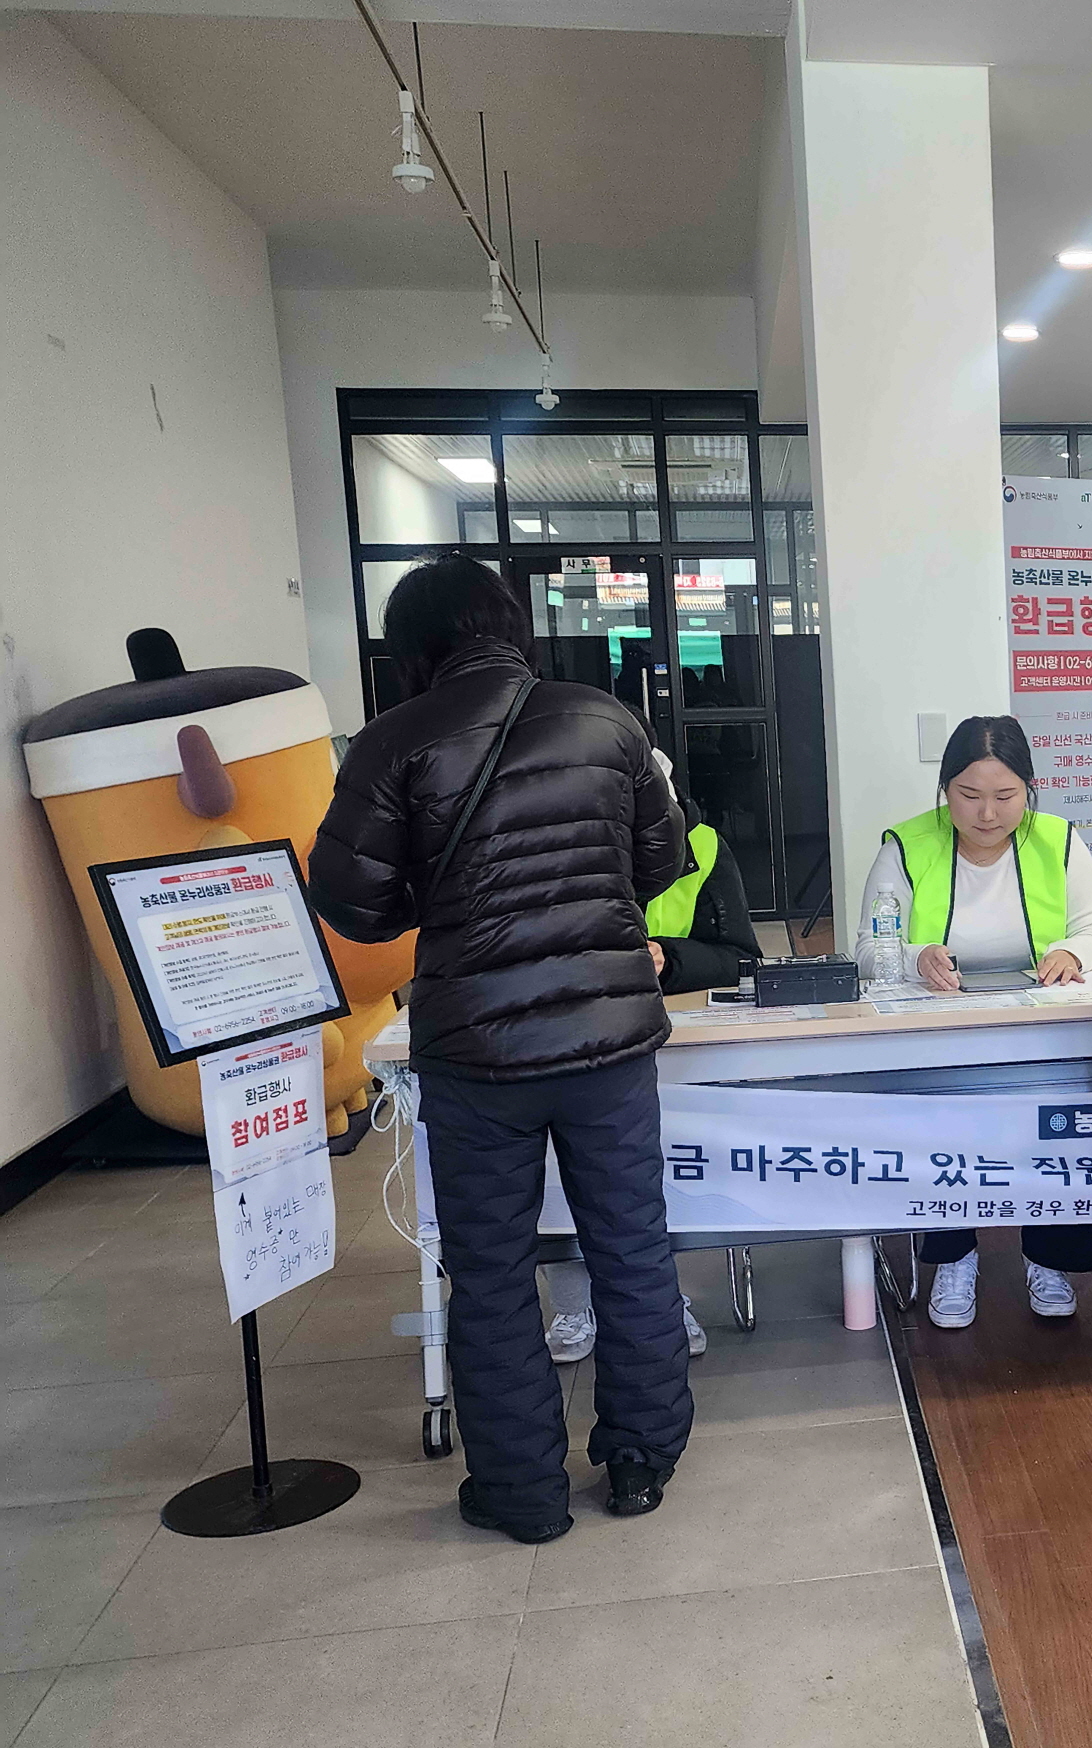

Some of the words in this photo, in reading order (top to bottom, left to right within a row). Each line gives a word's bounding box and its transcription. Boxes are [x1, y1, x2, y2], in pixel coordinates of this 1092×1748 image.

[1020, 548, 1082, 559] 농림축산식품부에서
[1012, 568, 1063, 586] 농축산물
[1016, 656, 1059, 670] 문의사항
[1020, 676, 1051, 687] 고객센터
[1052, 676, 1080, 686] 운영시간
[1032, 735, 1051, 748] 당일
[1054, 734, 1072, 746] 신선
[1074, 733, 1092, 746] 국산
[1054, 756, 1072, 768] 구매
[1031, 777, 1049, 790] 본인
[1051, 776, 1070, 788] 확인
[140, 892, 178, 908] 농축산물
[178, 882, 232, 901] 온누리상품권
[230, 873, 274, 892] 환급행사
[245, 1076, 291, 1106] 환급행사
[231, 1099, 308, 1148] 참여점포
[667, 1144, 709, 1180] 금
[731, 1145, 909, 1184] 마주하고
[929, 1153, 1014, 1187] 있는
[306, 1181, 326, 1197] 매장
[906, 1200, 968, 1217] 고객이
[977, 1200, 1016, 1217] 많을
[1026, 1200, 1065, 1217] 경우
